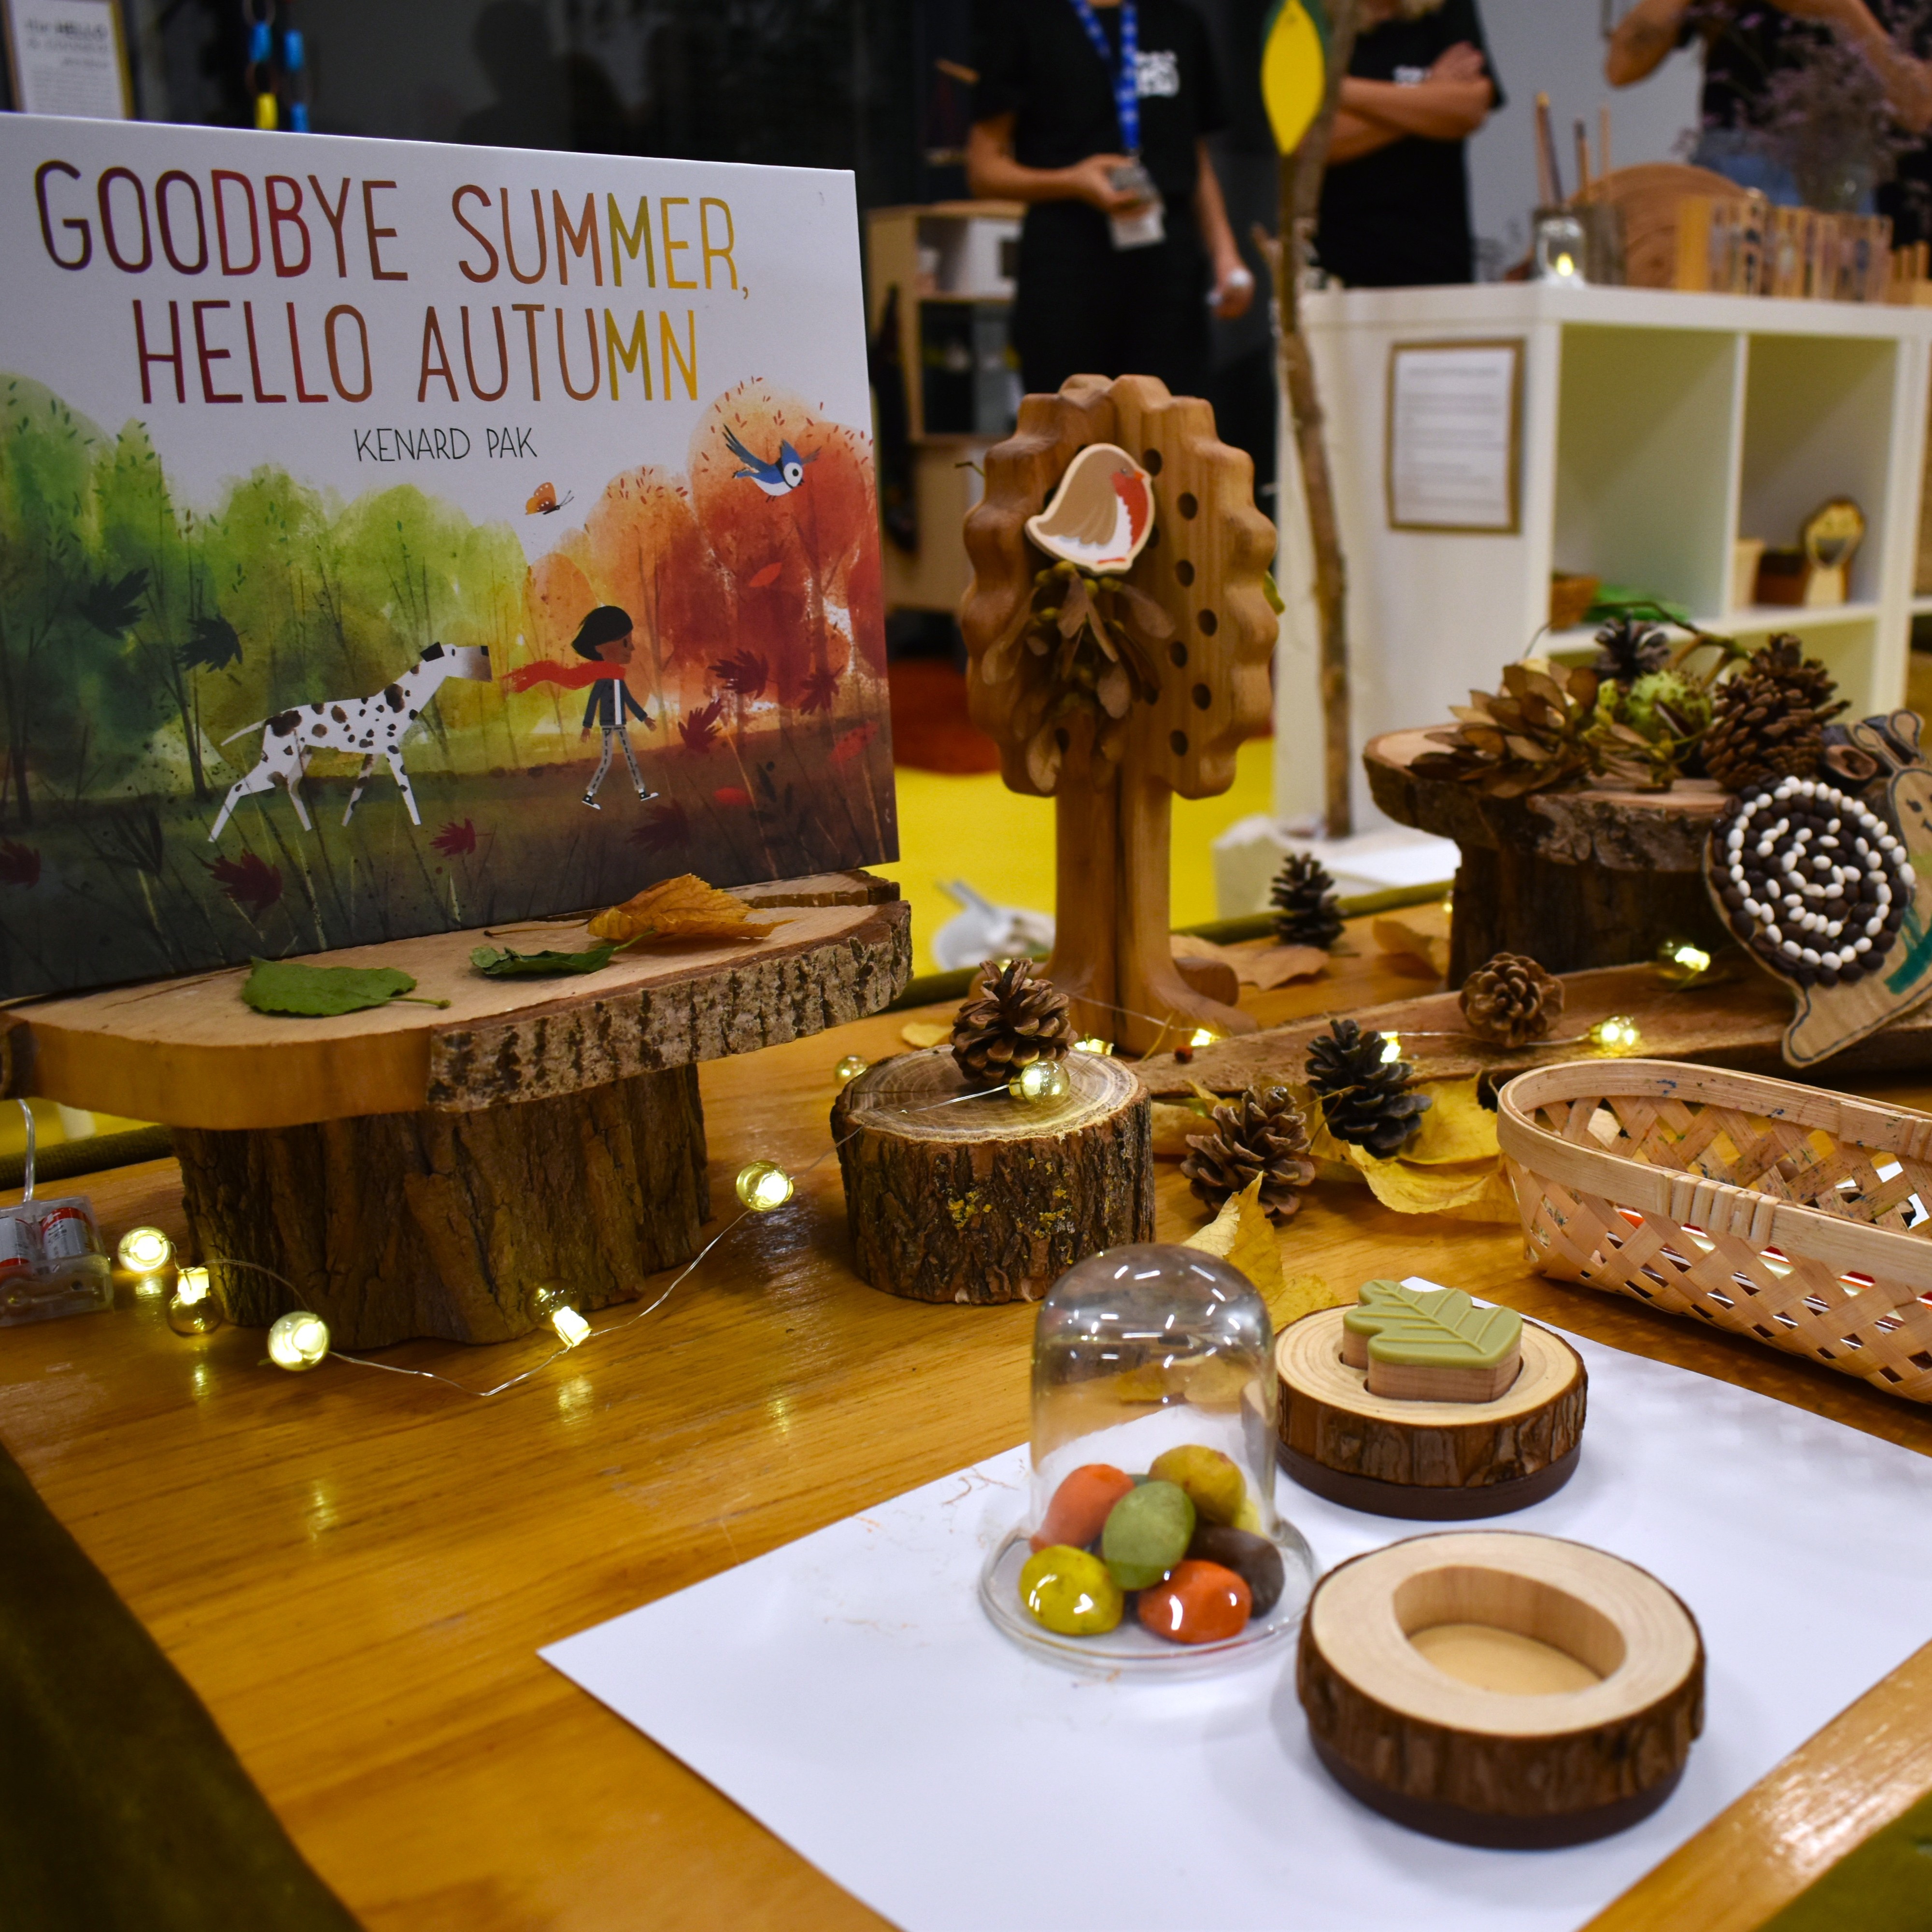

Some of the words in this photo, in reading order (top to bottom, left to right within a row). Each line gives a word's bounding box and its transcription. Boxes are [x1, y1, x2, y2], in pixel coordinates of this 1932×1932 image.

[34, 159, 409, 281] GOODBYE
[452, 184, 749, 300] SUMMER,
[132, 299, 373, 404] HELLO
[417, 304, 698, 403] AUTUMN
[354, 427, 471, 462] KENARD
[486, 426, 538, 459] PAK
